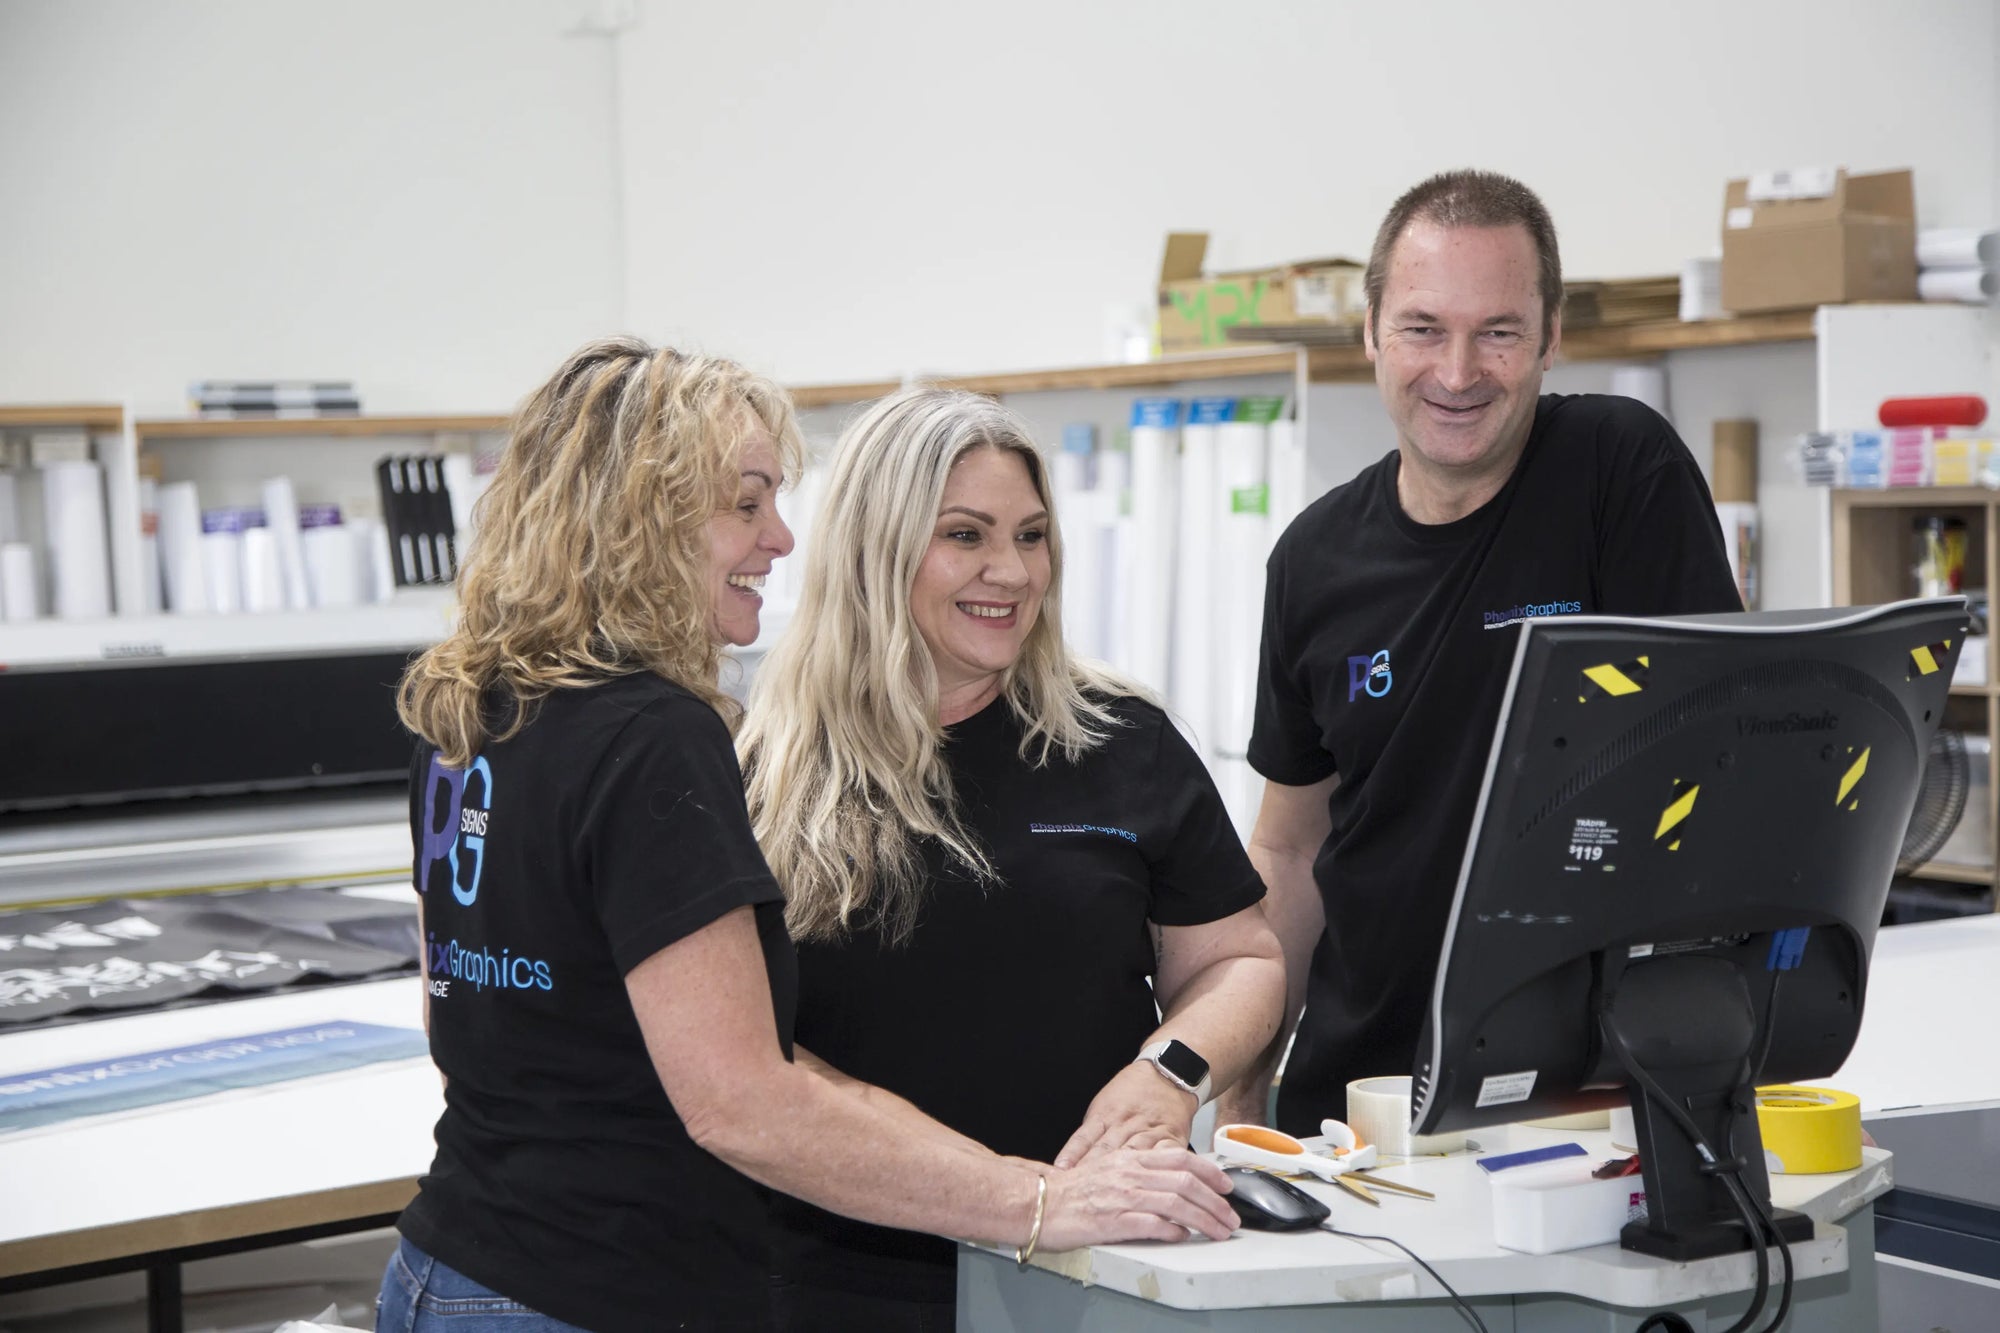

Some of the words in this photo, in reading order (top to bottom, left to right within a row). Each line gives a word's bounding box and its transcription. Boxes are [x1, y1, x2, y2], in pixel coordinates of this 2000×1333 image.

[1347, 649, 1393, 702] PG
[1370, 662, 1390, 676] SIGNS
[420, 750, 493, 906] PG
[460, 807, 489, 836] SIGNS
[1569, 844, 1603, 861] $119
